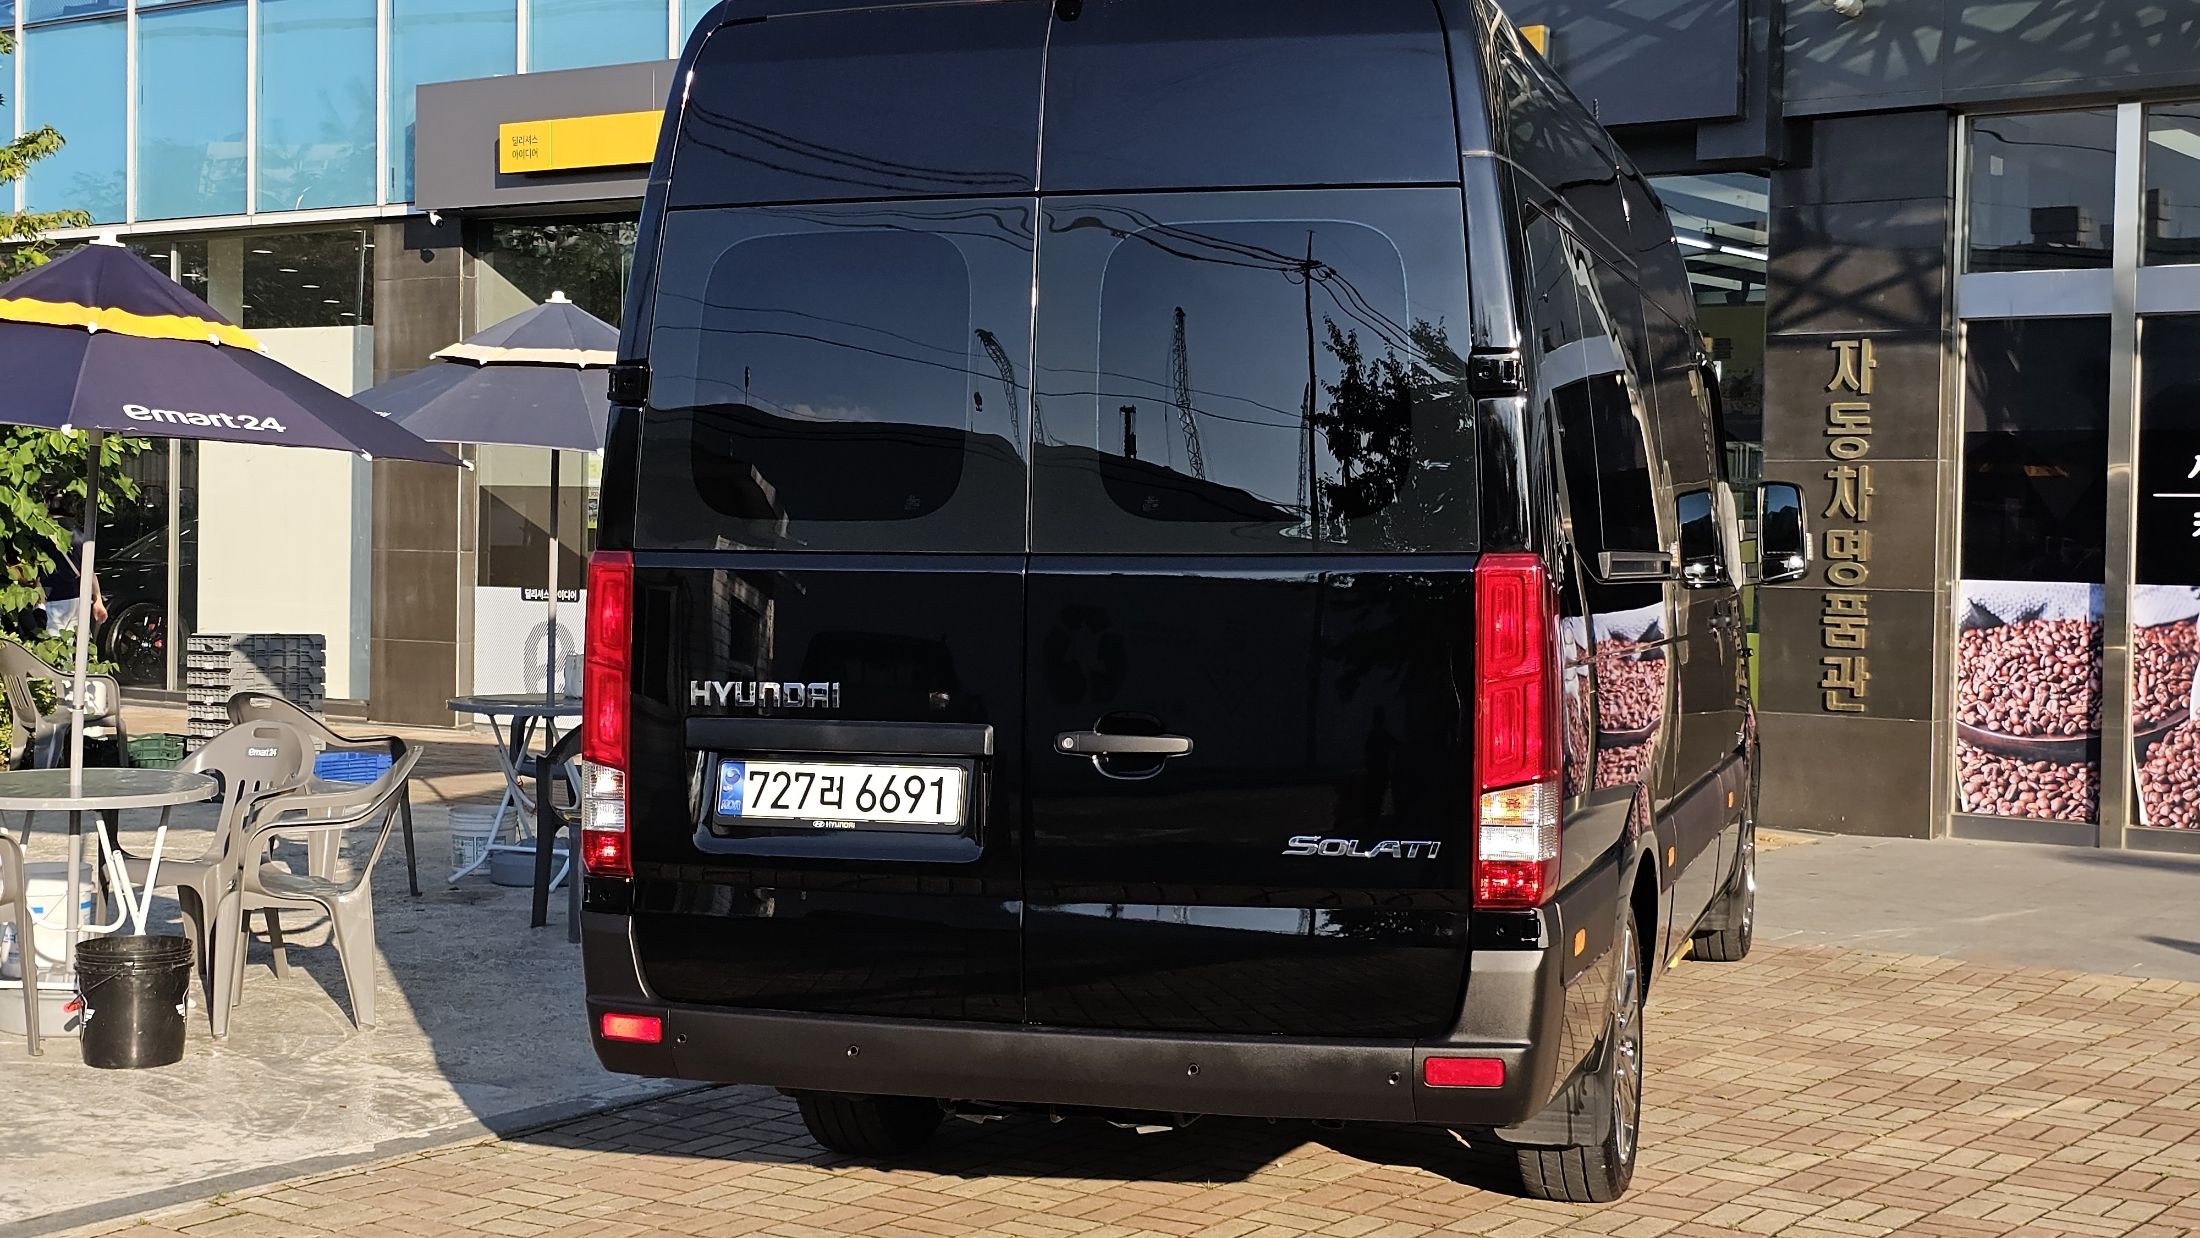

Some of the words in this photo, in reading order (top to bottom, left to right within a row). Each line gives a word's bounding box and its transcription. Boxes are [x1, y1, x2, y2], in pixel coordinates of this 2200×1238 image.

[511, 134, 538, 147] 딜리셔스
[511, 148, 538, 161] 아이디어
[122, 404, 287, 433] emart24
[554, 589, 577, 601] 이디어
[690, 680, 840, 709] HYUNDAI
[248, 747, 278, 757] emart24
[749, 770, 844, 811] 727러
[855, 773, 944, 815] 6691
[825, 820, 856, 829] HYUNDAI
